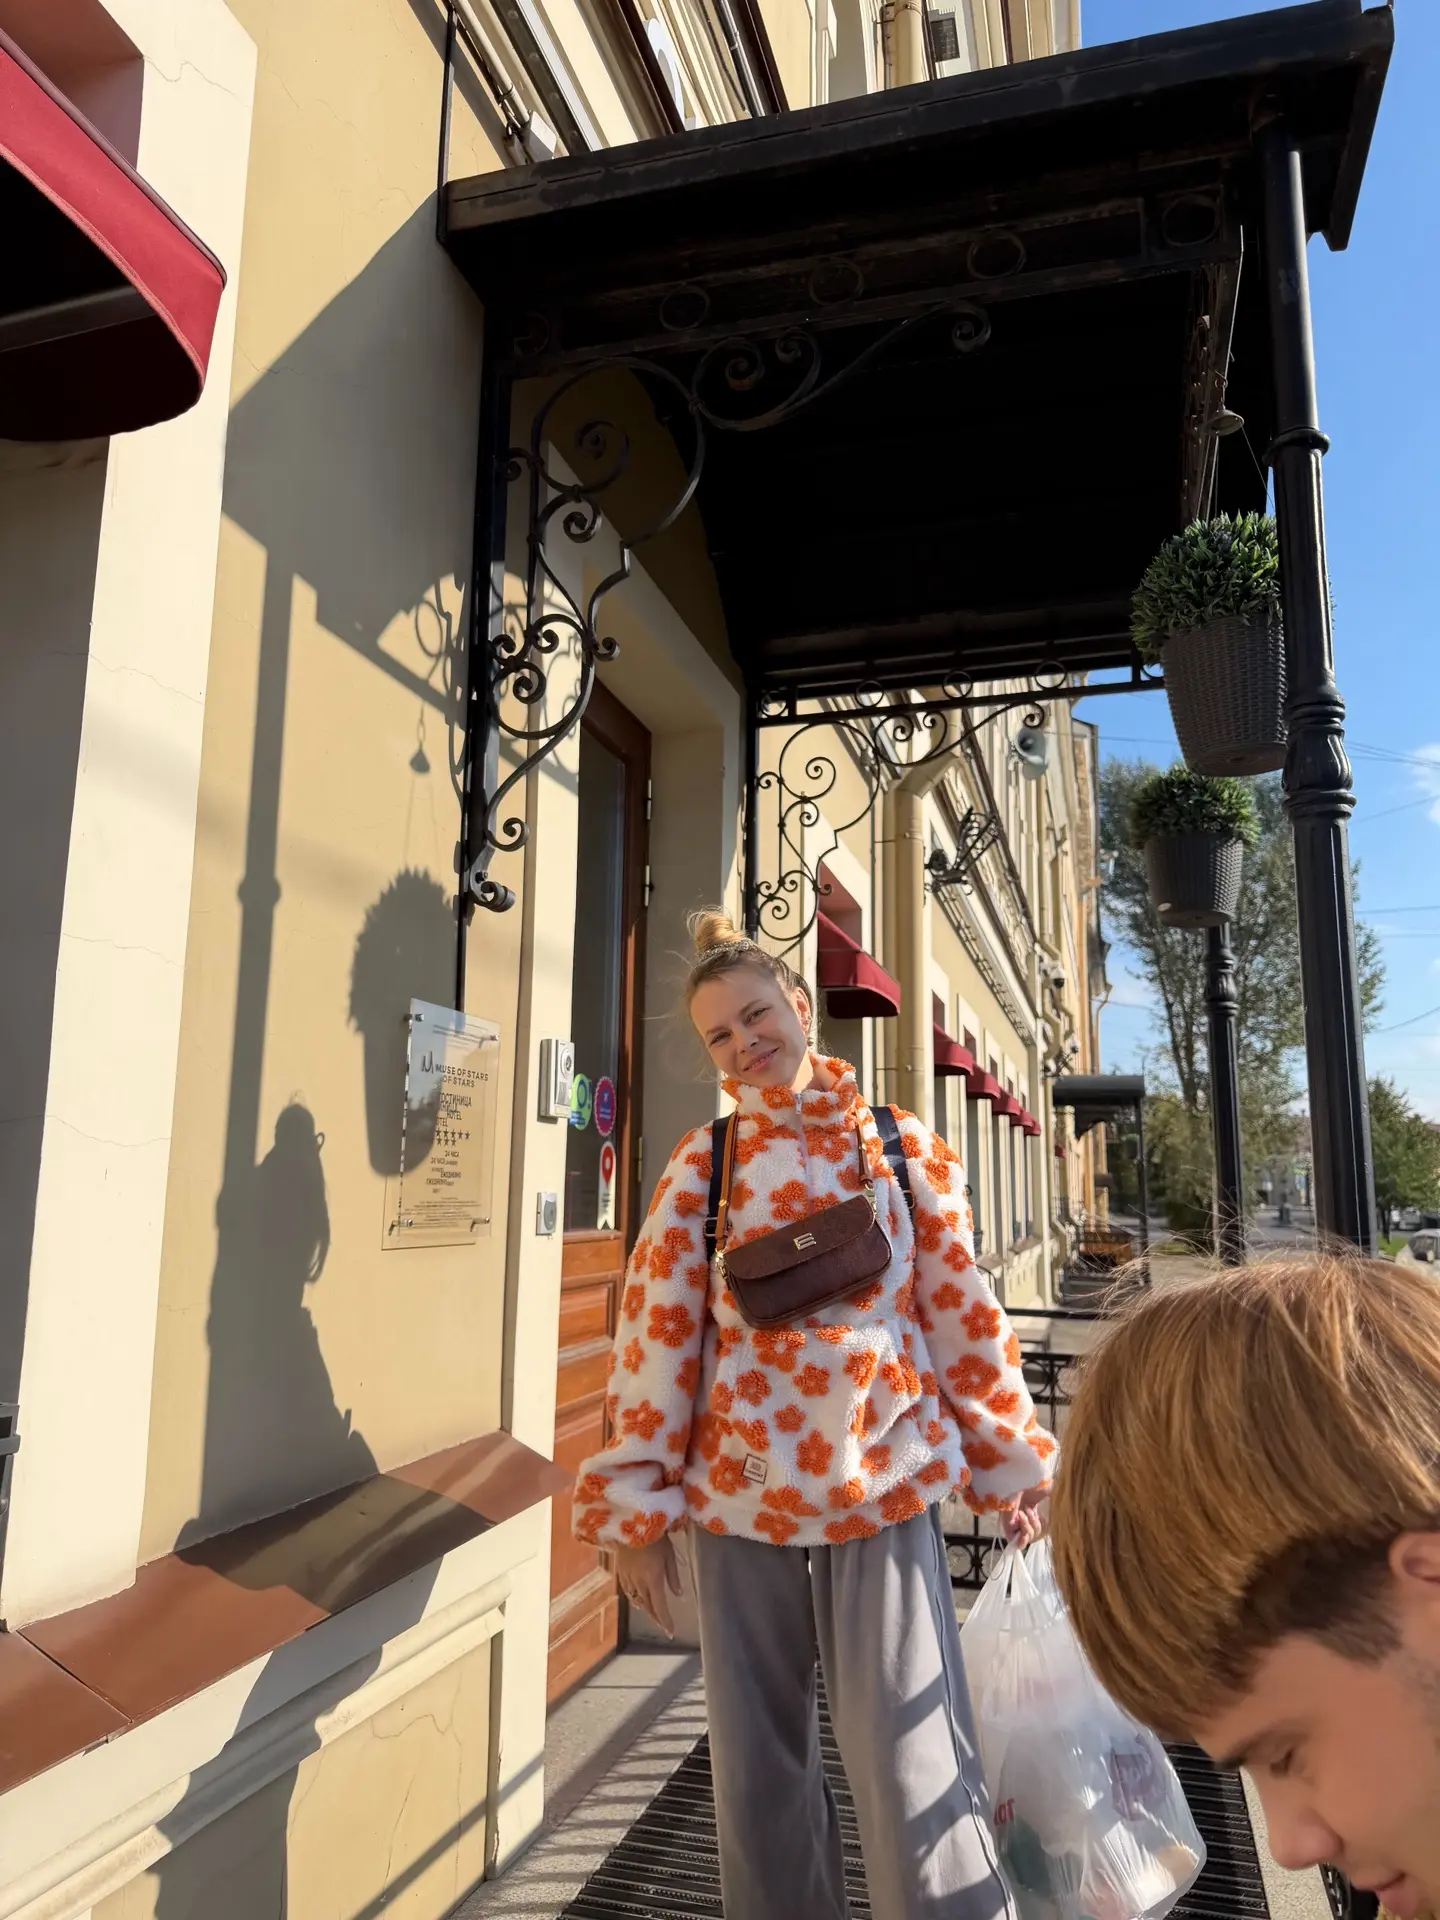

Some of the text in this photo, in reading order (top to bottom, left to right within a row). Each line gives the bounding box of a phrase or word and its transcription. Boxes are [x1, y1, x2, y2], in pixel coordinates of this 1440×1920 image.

[435, 1063, 489, 1082] MUSE OF STARS
